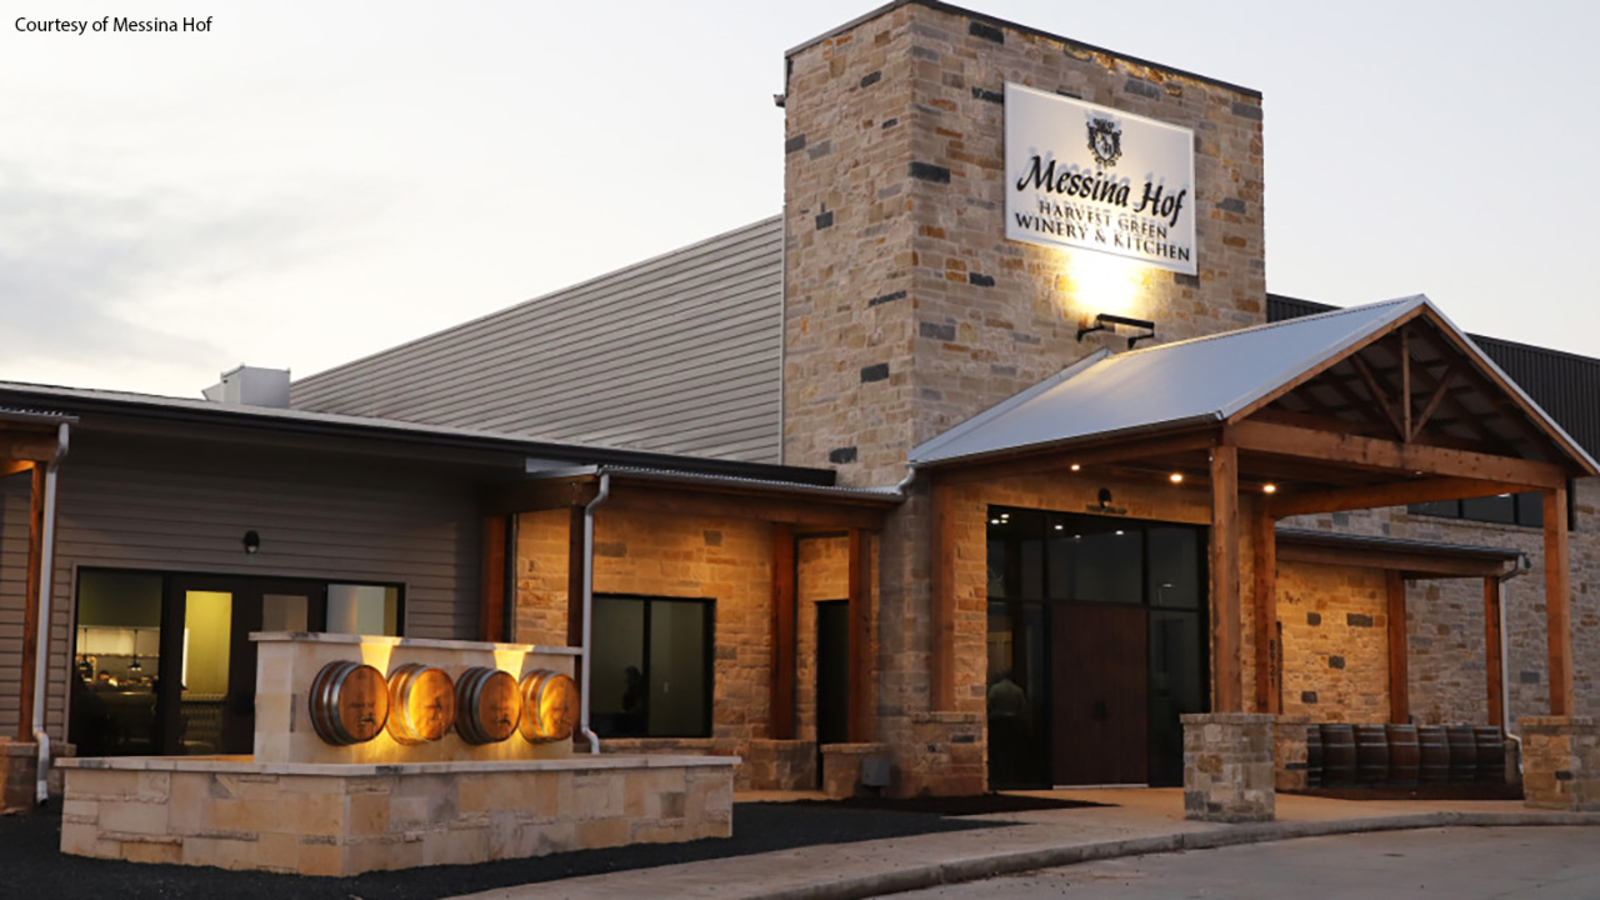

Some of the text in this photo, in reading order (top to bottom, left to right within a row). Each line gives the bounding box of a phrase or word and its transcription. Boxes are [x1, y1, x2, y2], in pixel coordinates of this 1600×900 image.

[1016, 155, 1187, 228] Messina Hof
[1015, 212, 1190, 262] WINERY & KITCHEN
[1039, 200, 1167, 239] HARVEST GREEN
